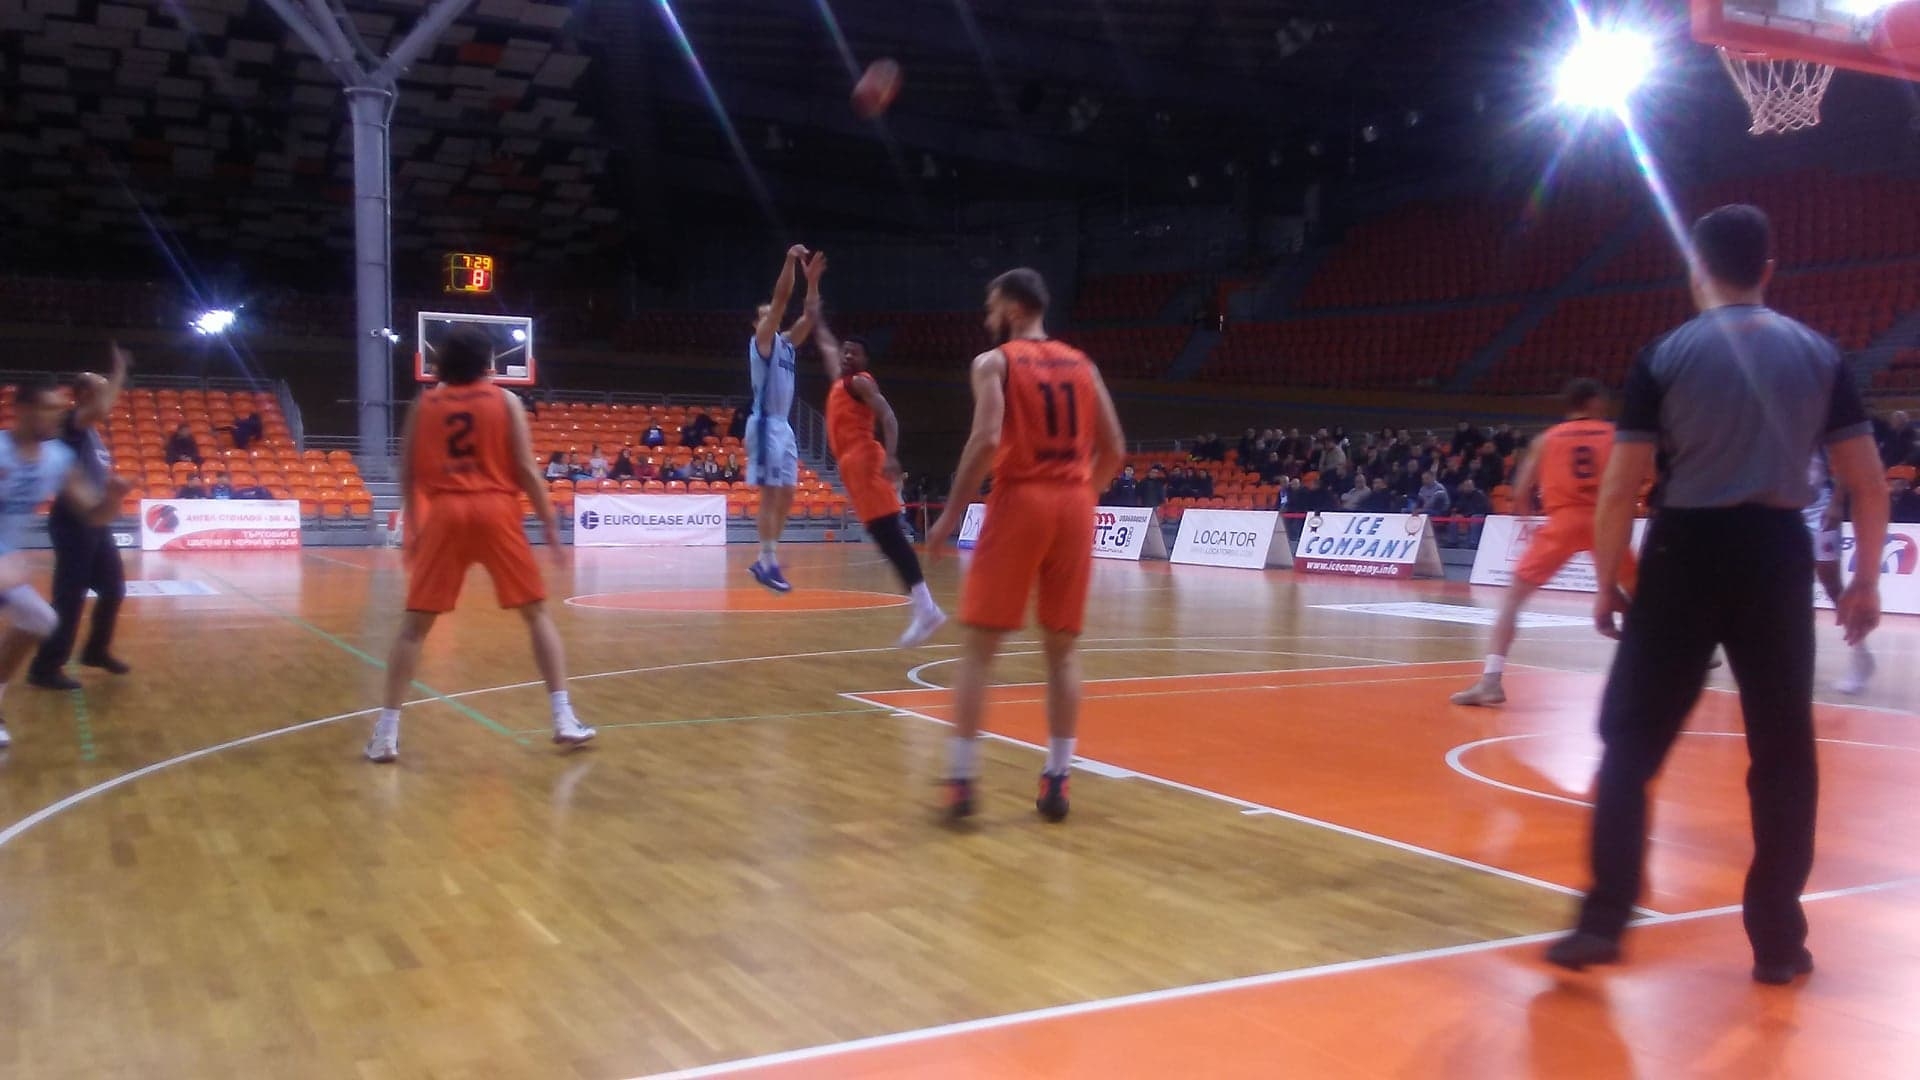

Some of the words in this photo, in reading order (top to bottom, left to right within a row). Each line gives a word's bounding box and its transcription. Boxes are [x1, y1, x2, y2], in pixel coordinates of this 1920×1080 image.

[473, 270, 485, 287] 8
[1038, 382, 1078, 438] 11
[446, 412, 476, 458] 2
[1572, 446, 1596, 479] 8
[604, 514, 684, 526] EUROLEASE
[687, 514, 722, 526] AUTO
[1339, 516, 1384, 535] ICE
[1193, 530, 1257, 547] LOCATOR
[1305, 536, 1416, 559] COMPANY
[1306, 561, 1398, 575] www.icecompany.info
